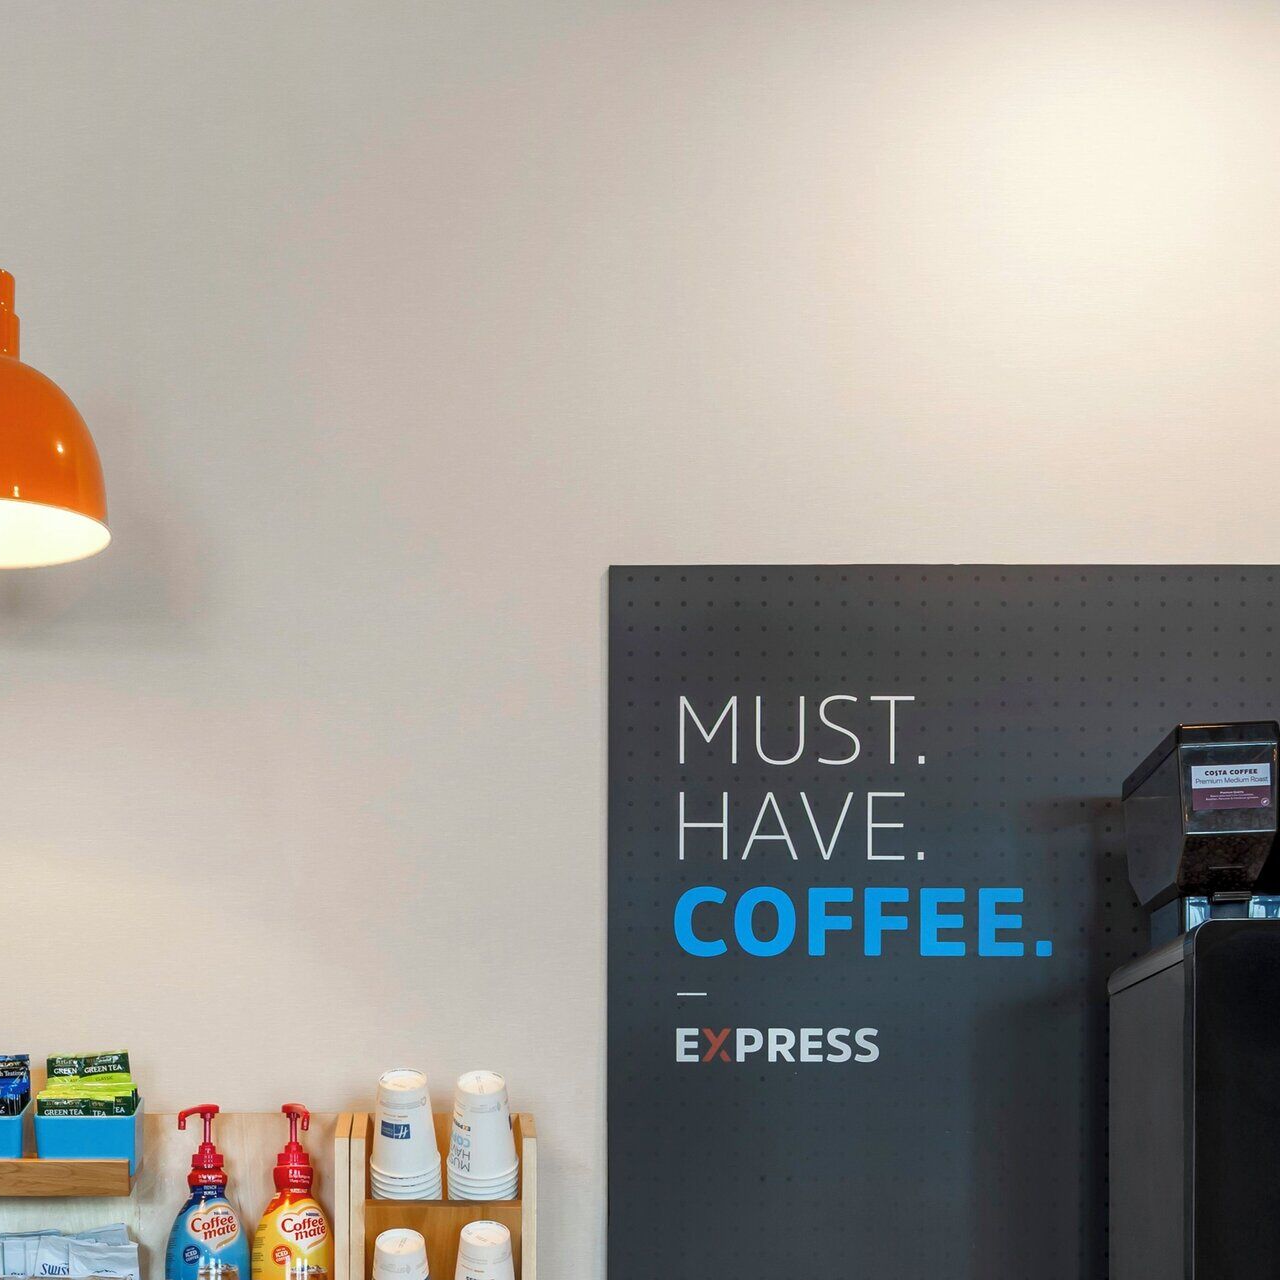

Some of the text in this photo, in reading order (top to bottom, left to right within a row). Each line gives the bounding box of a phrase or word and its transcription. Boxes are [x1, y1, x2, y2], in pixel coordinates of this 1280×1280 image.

[678, 695, 926, 766] MUST.
[678, 791, 926, 861] HAVE.
[673, 886, 1053, 958] COFFEE.
[675, 1026, 881, 1064] EXPRESS
[83, 1066, 107, 1074] GREEN
[191, 1215, 234, 1233] Coffee
[203, 1223, 237, 1240] mate
[281, 1216, 324, 1233] Coffee
[294, 1225, 326, 1241] mate
